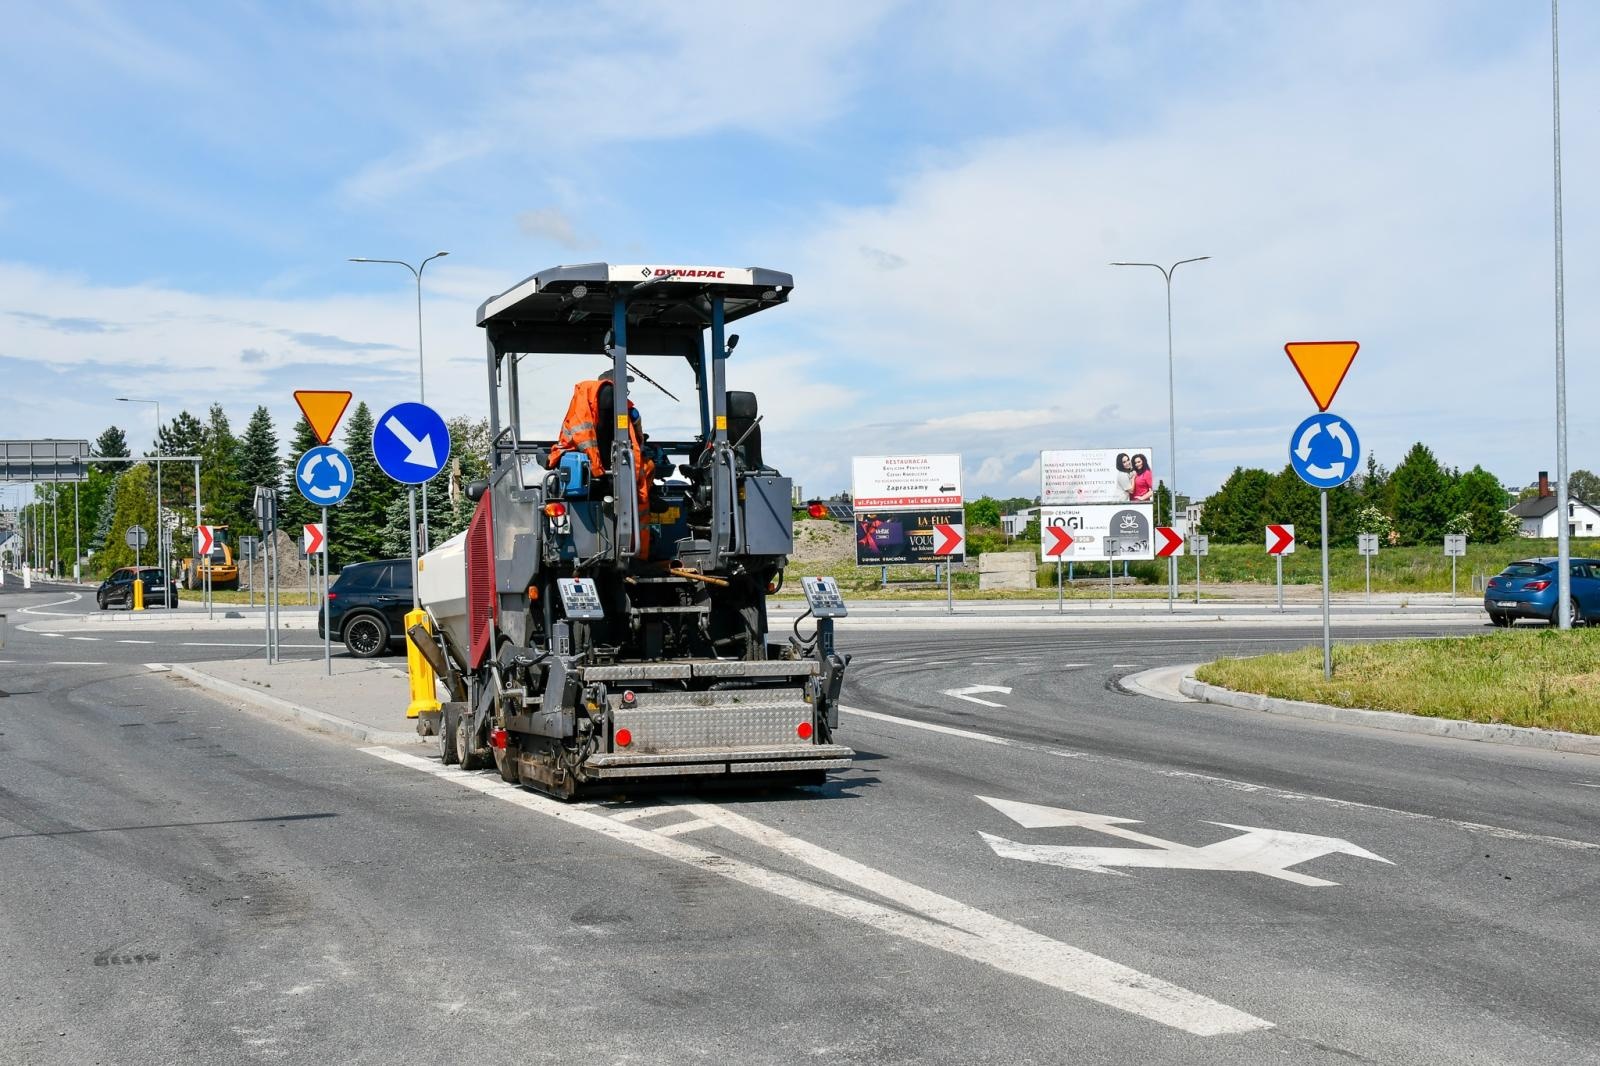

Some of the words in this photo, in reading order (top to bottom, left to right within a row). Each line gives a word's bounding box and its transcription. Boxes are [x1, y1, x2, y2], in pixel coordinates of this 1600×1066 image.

[654, 269, 725, 278] DYNAPAC
[918, 516, 928, 525] LA
[909, 536, 934, 545] VOUC
